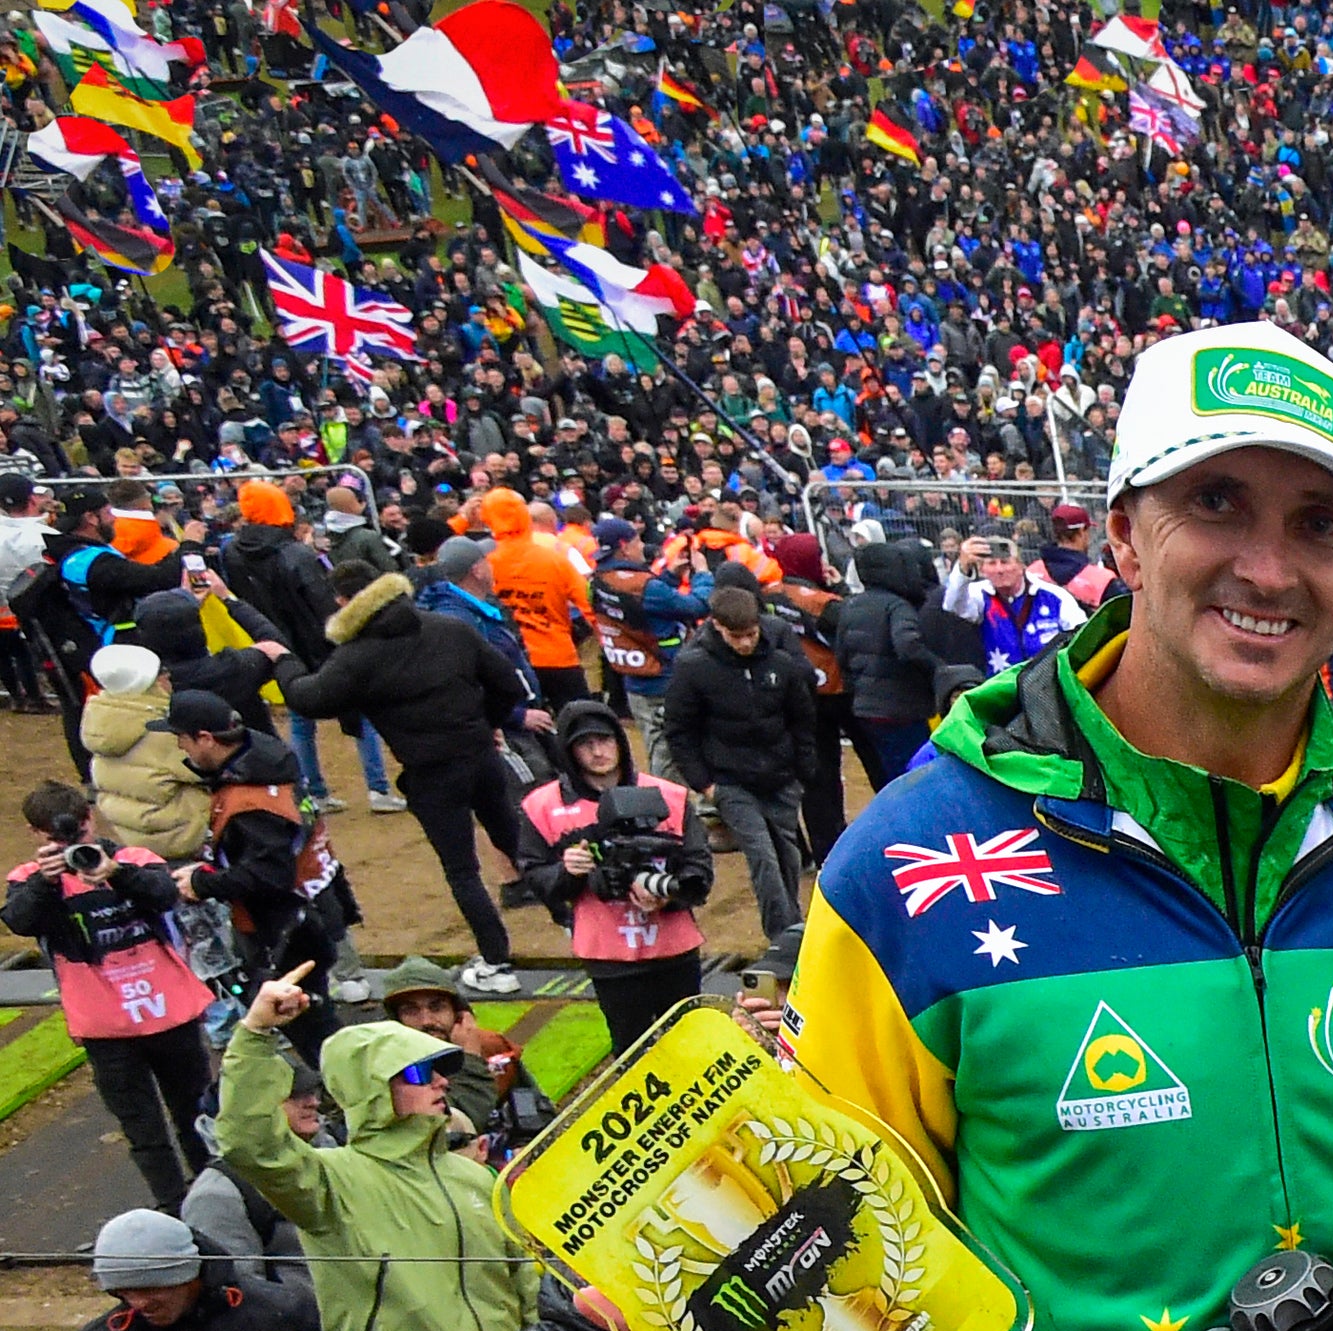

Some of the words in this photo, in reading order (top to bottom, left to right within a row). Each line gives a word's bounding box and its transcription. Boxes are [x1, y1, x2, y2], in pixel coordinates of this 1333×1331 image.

[1253, 369, 1291, 387] TEAM
[1245, 381, 1333, 421] AUSTRALIA
[618, 924, 659, 949] TV
[120, 979, 152, 1001] 50
[121, 992, 167, 1024] TV
[581, 1071, 672, 1165] 2024
[1060, 1091, 1188, 1117] MOTORCYCLING
[1063, 1105, 1190, 1129] AUSTRALIA
[553, 1150, 641, 1235] MONSTER
[636, 1081, 705, 1152] ENERGY
[703, 1051, 737, 1086] FIM
[561, 1148, 670, 1256] MOTOCROSS
[665, 1123, 692, 1149] OF
[691, 1055, 763, 1125] NATIONS
[744, 1211, 806, 1272] MONSTER
[765, 1225, 833, 1302] MXON
